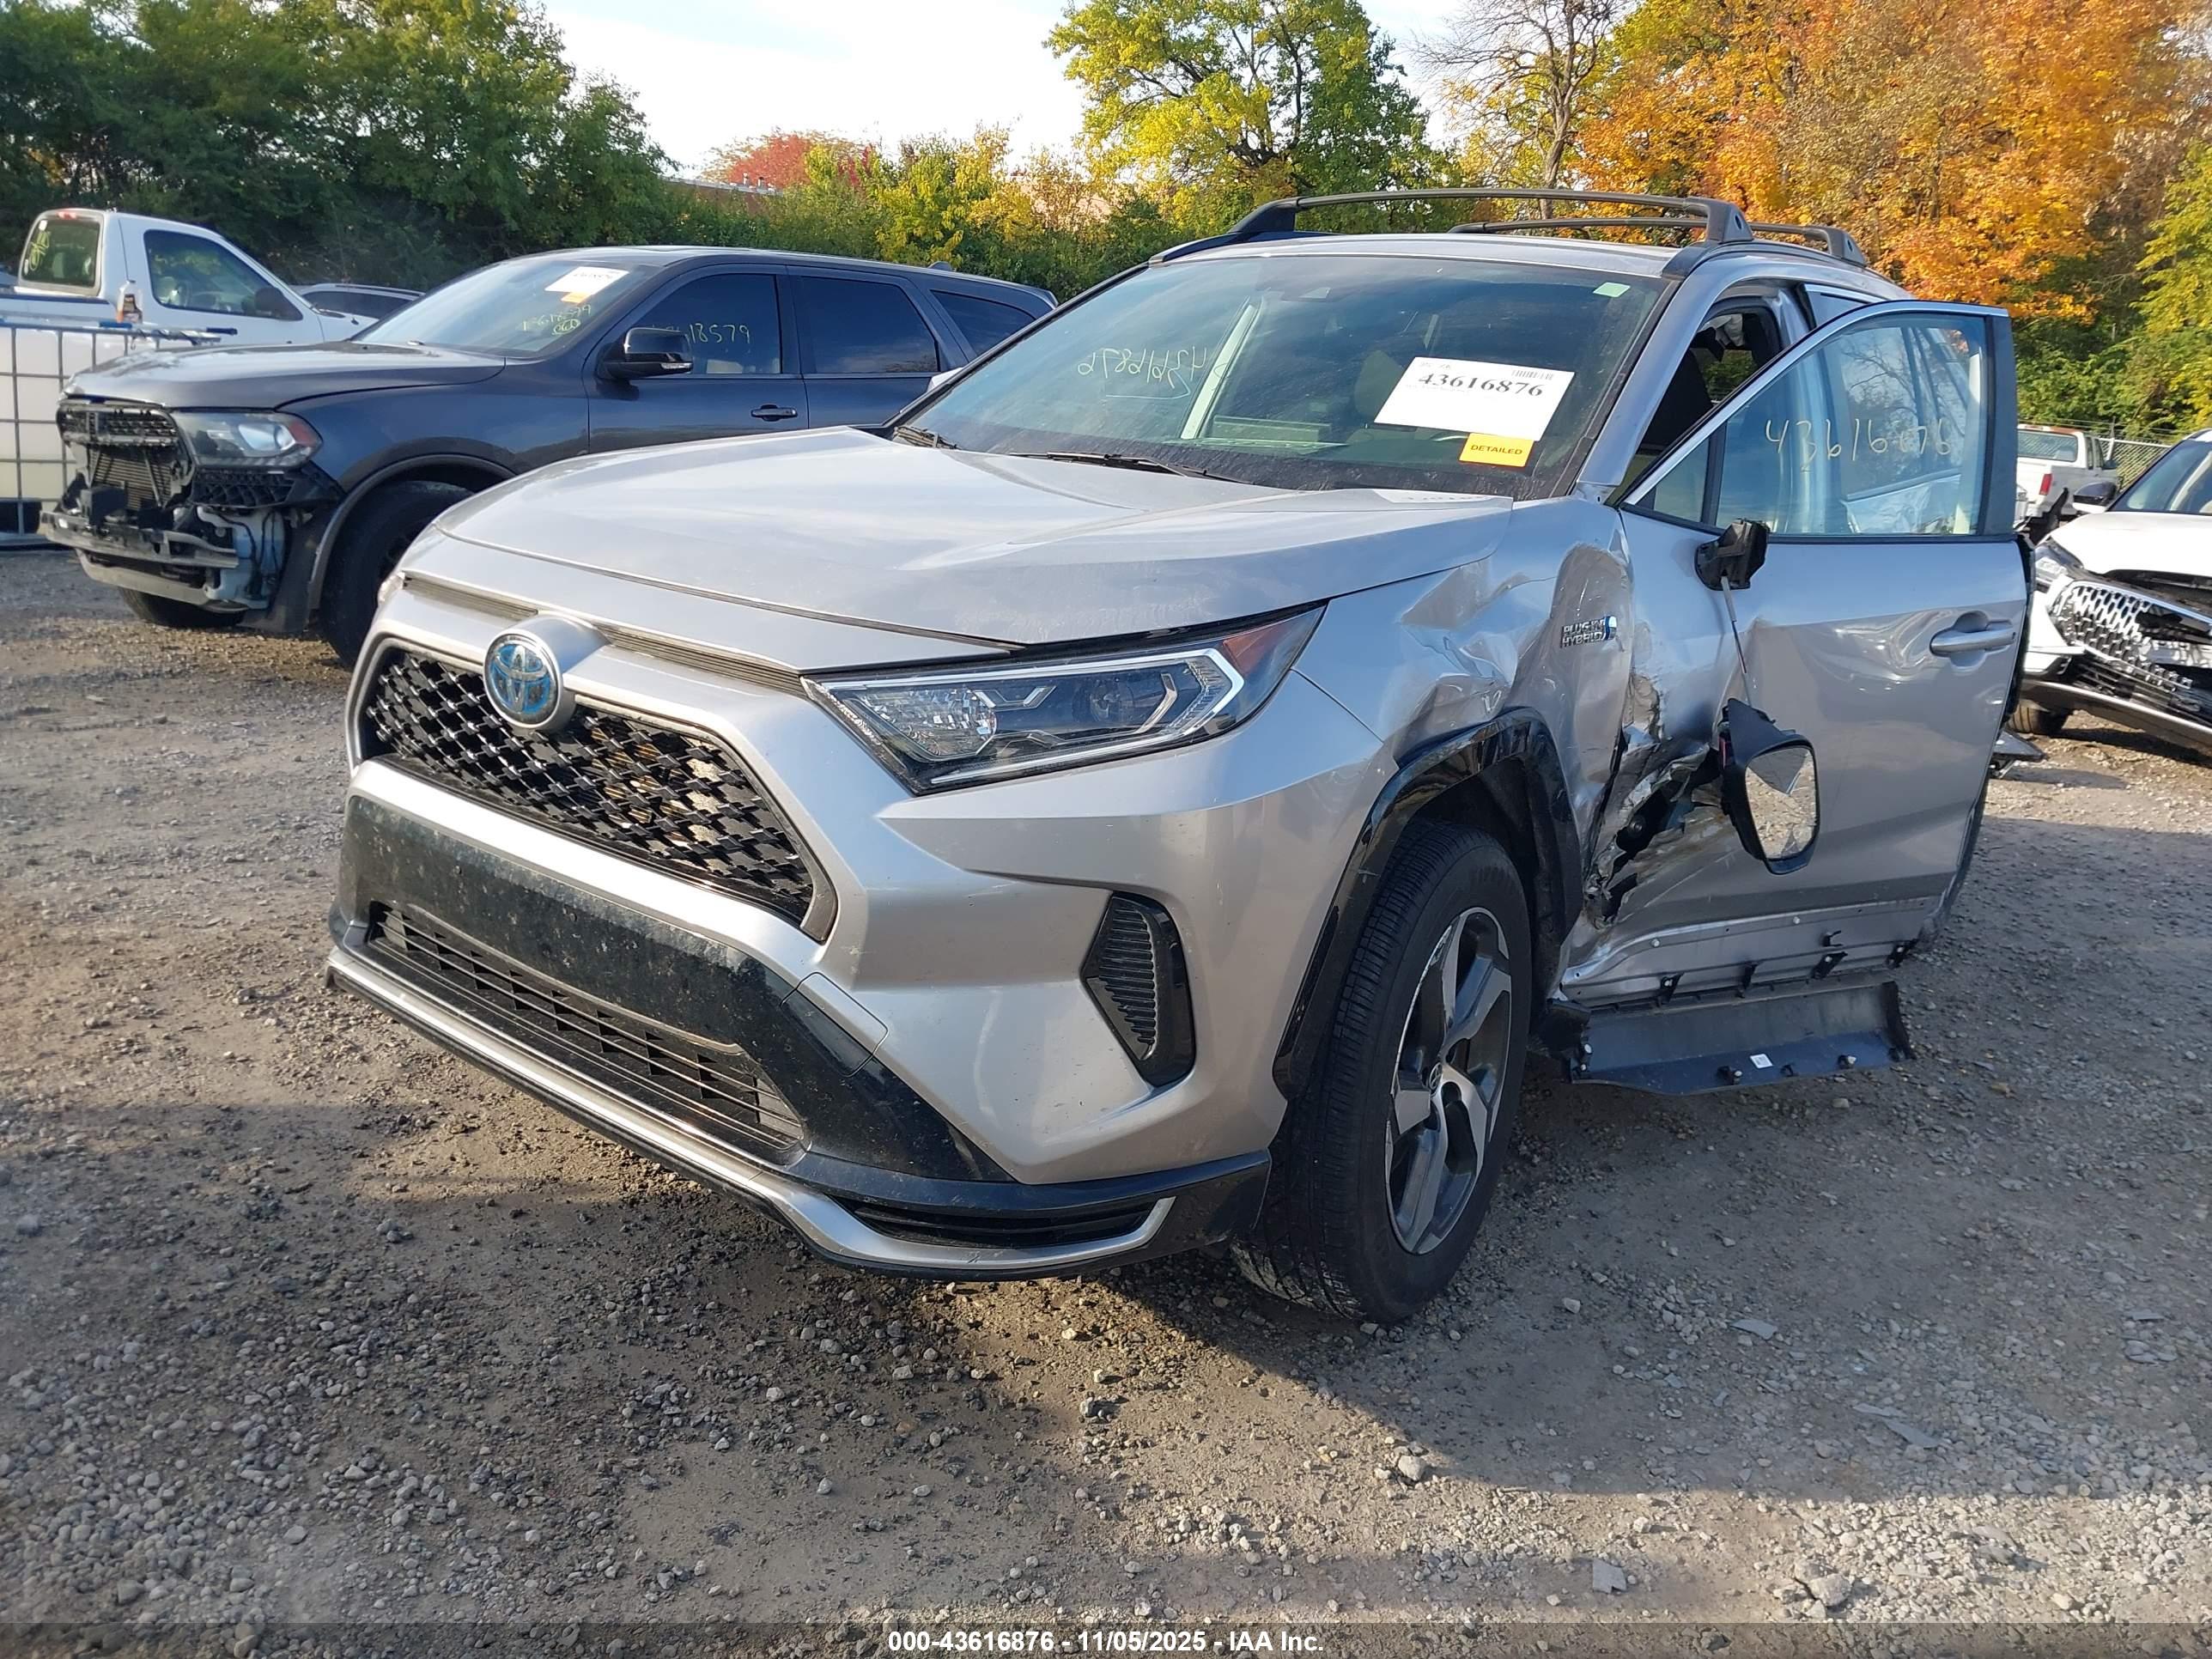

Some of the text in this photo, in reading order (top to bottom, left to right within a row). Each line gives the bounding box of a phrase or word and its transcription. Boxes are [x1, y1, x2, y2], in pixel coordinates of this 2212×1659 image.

[1419, 373, 1543, 397] 43616876
[1471, 444, 1523, 455] DETAILED
[1562, 631, 1603, 647] HYBRID
